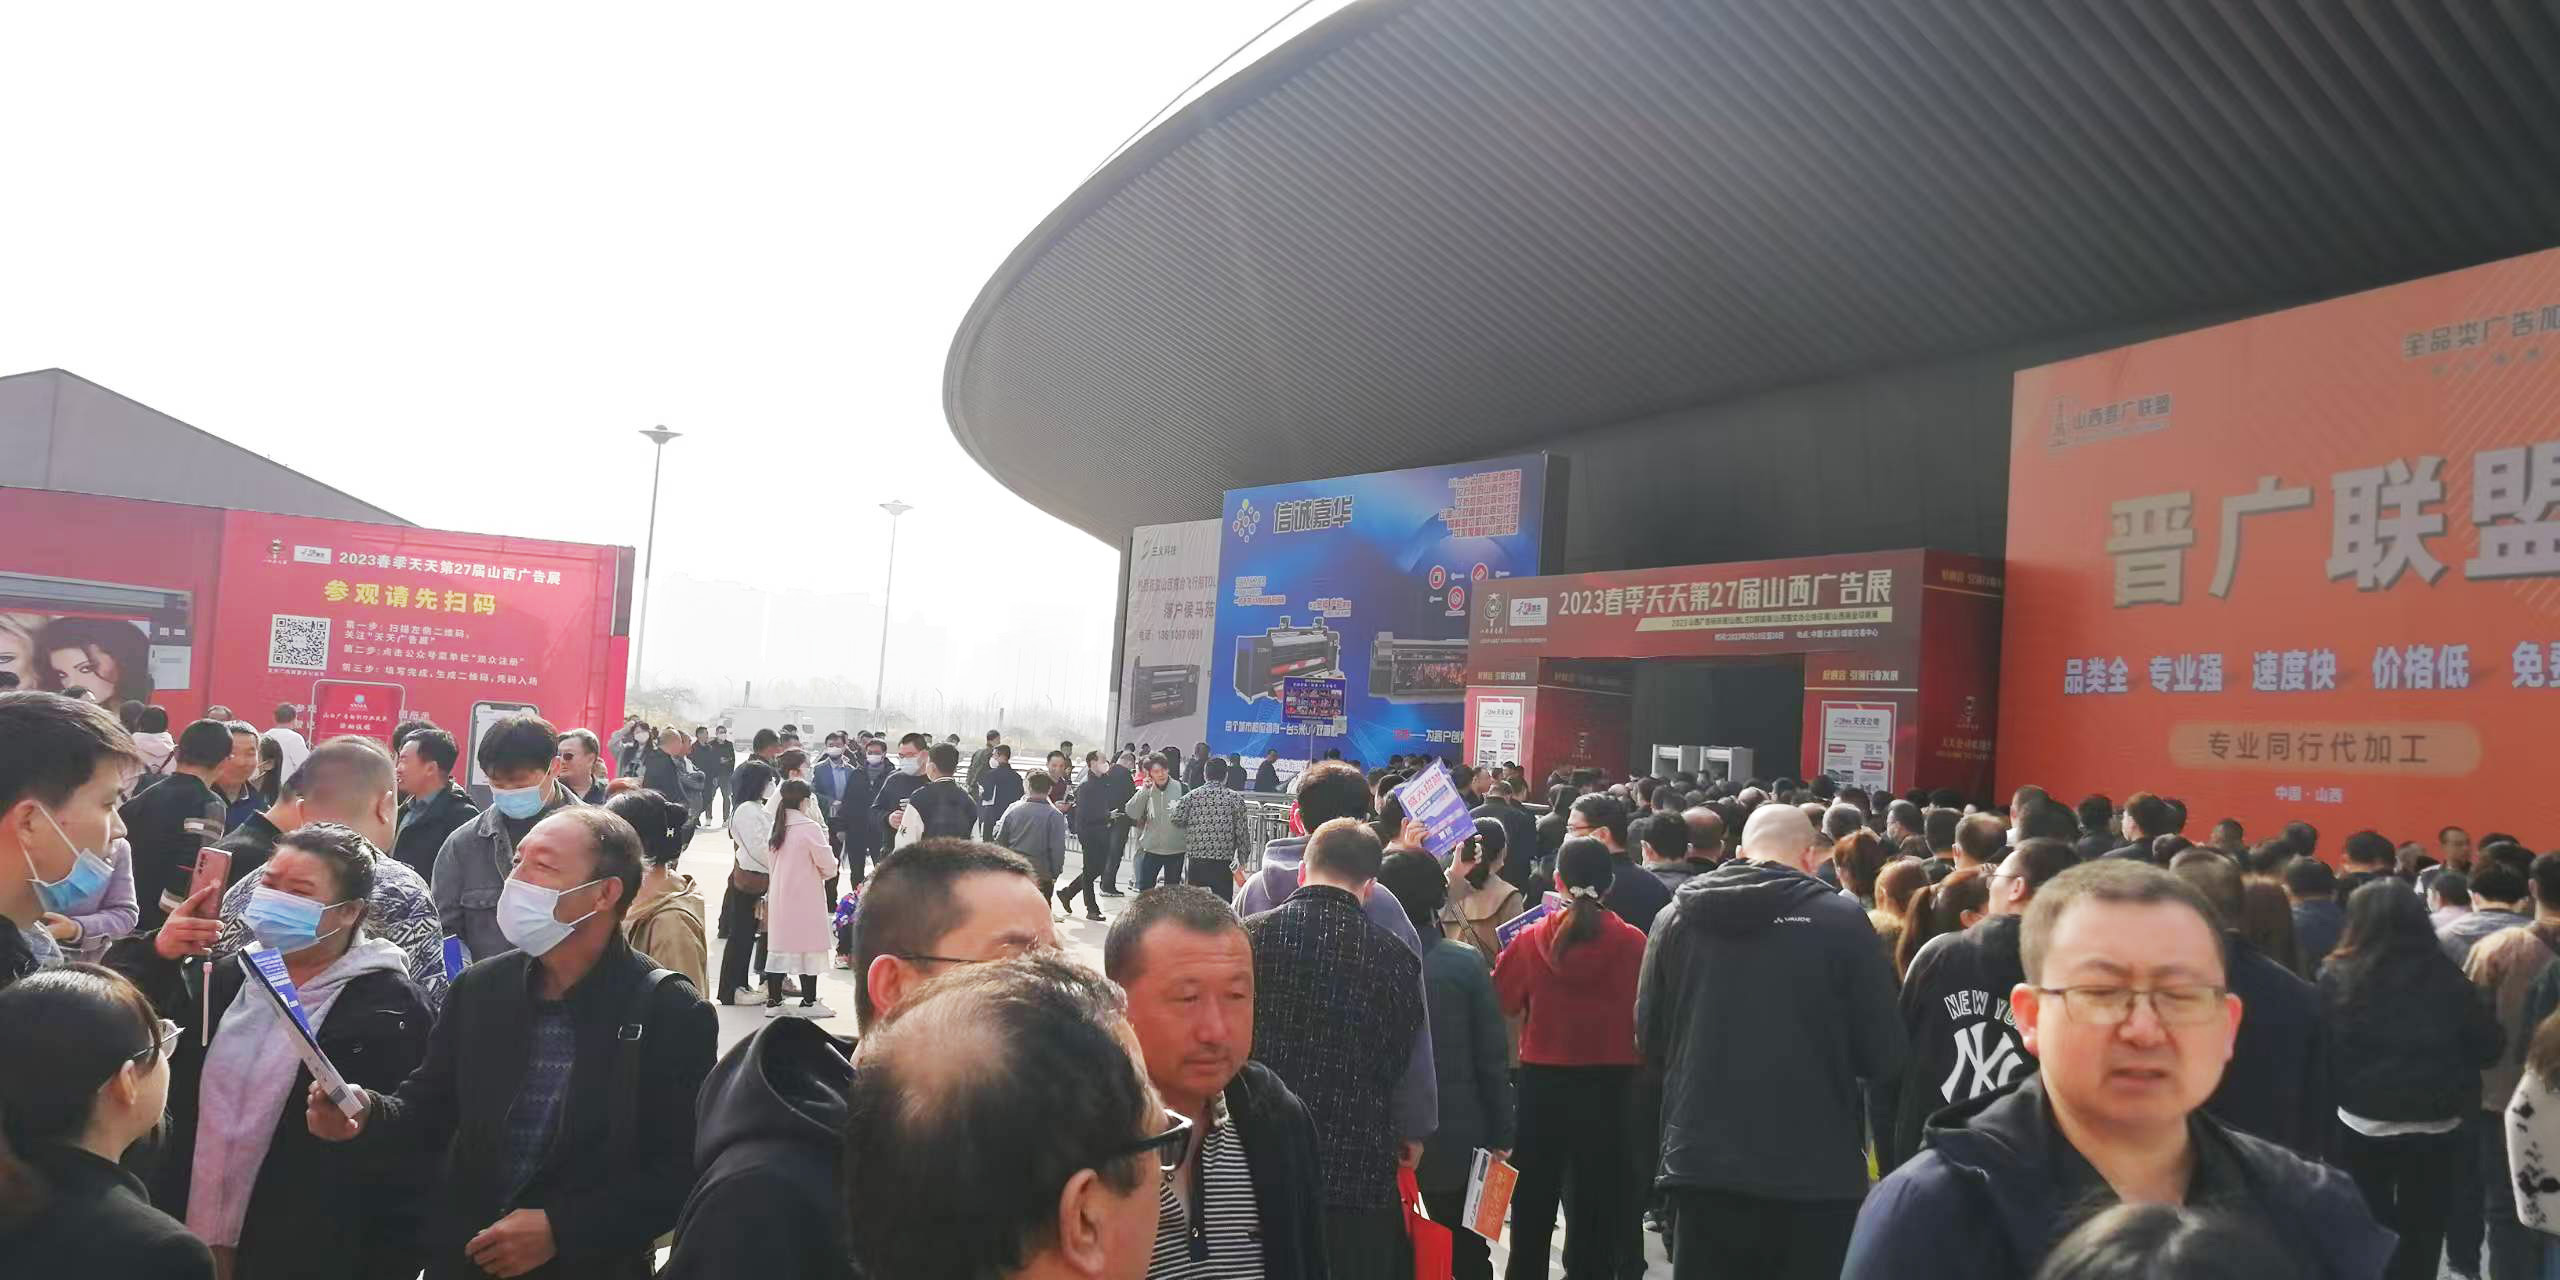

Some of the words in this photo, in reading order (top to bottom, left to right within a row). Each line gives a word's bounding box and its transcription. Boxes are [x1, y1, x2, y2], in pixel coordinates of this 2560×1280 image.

[1273, 495, 1354, 534] 信诚嘉华
[2107, 442, 2560, 608] 晋广联盟
[340, 551, 561, 585] 2023春季天天第27届山西广告展
[324, 579, 496, 616] 参观请先扫码
[1558, 568, 1892, 616] 2023春季天天第27届山西广告展
[2064, 657, 2129, 696] 品类全
[2148, 652, 2223, 694] 专业强
[2251, 649, 2338, 692] 速度快
[2372, 643, 2471, 690] 价格低
[2207, 731, 2428, 765] 专业同行代加工
[1943, 989, 1989, 1021] NEW
[1993, 997, 2018, 1030] YO
